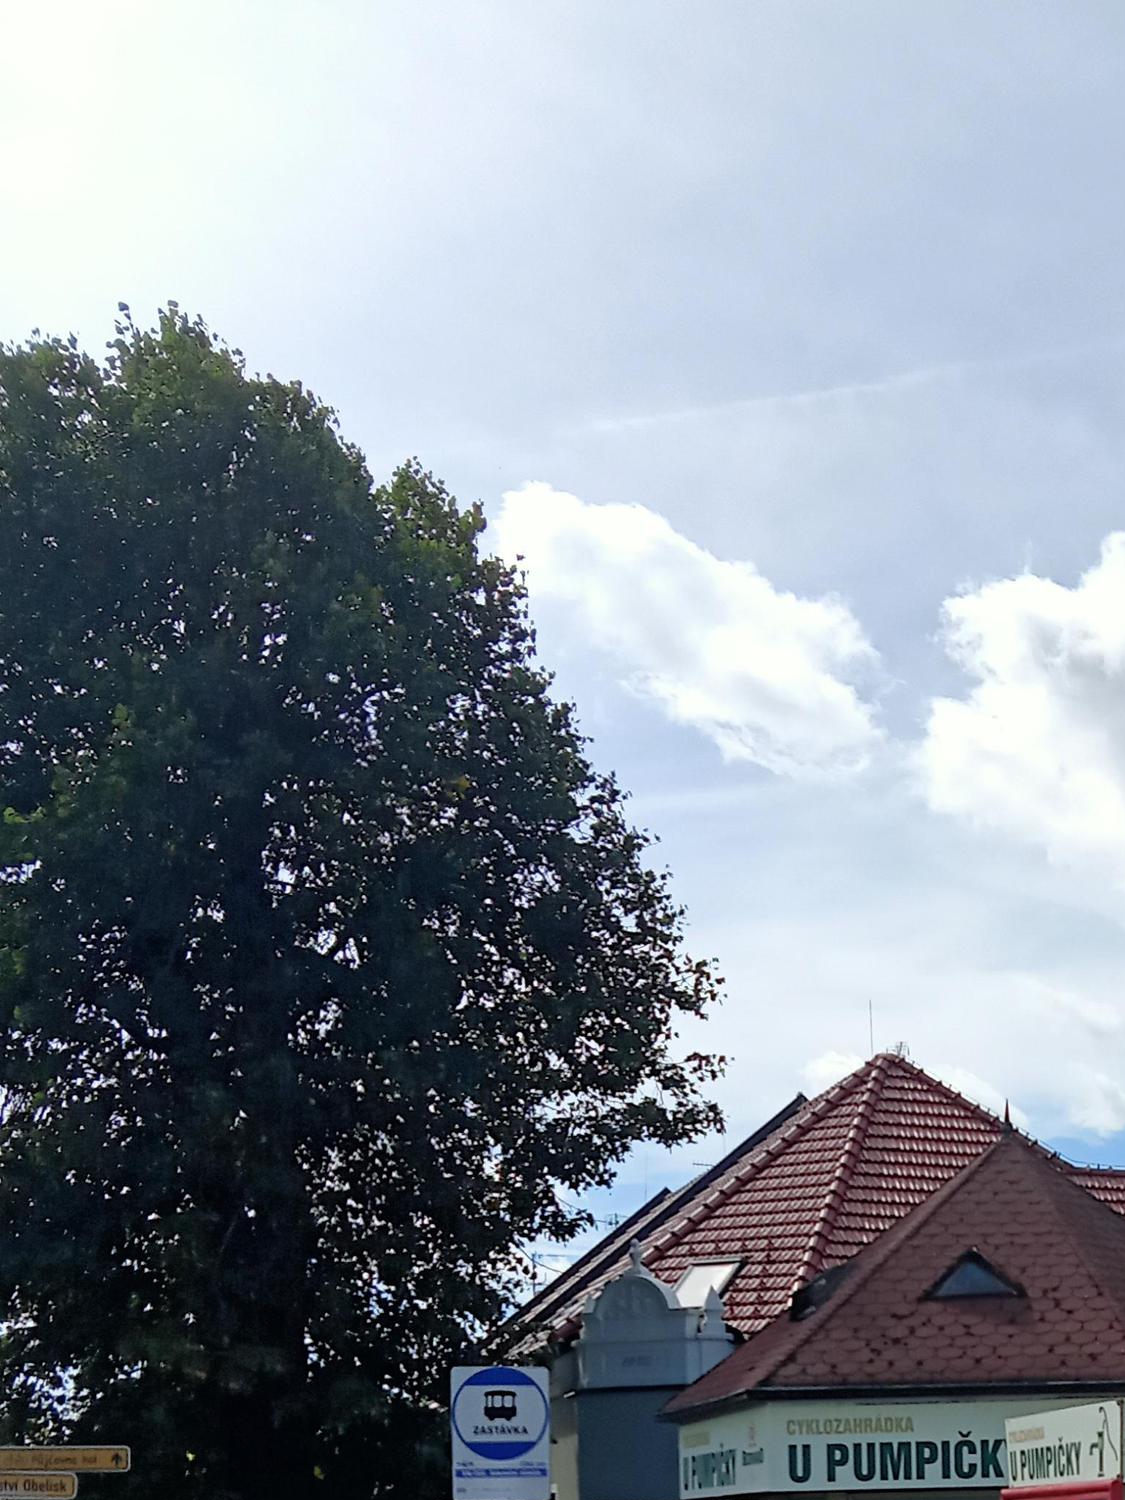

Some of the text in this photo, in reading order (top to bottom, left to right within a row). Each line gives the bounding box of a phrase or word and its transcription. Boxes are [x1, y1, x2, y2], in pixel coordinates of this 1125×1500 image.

[472, 1424, 529, 1435] ZASTÁVKA
[786, 1414, 915, 1435] CYKLOZAHRÁDKA
[787, 1444, 811, 1483] U
[826, 1431, 1006, 1482] PUMPIČK
[1010, 1450, 1018, 1482] U
[1020, 1436, 1081, 1481] PUMPIČKY
[23, 1479, 67, 1492] Obelisk
